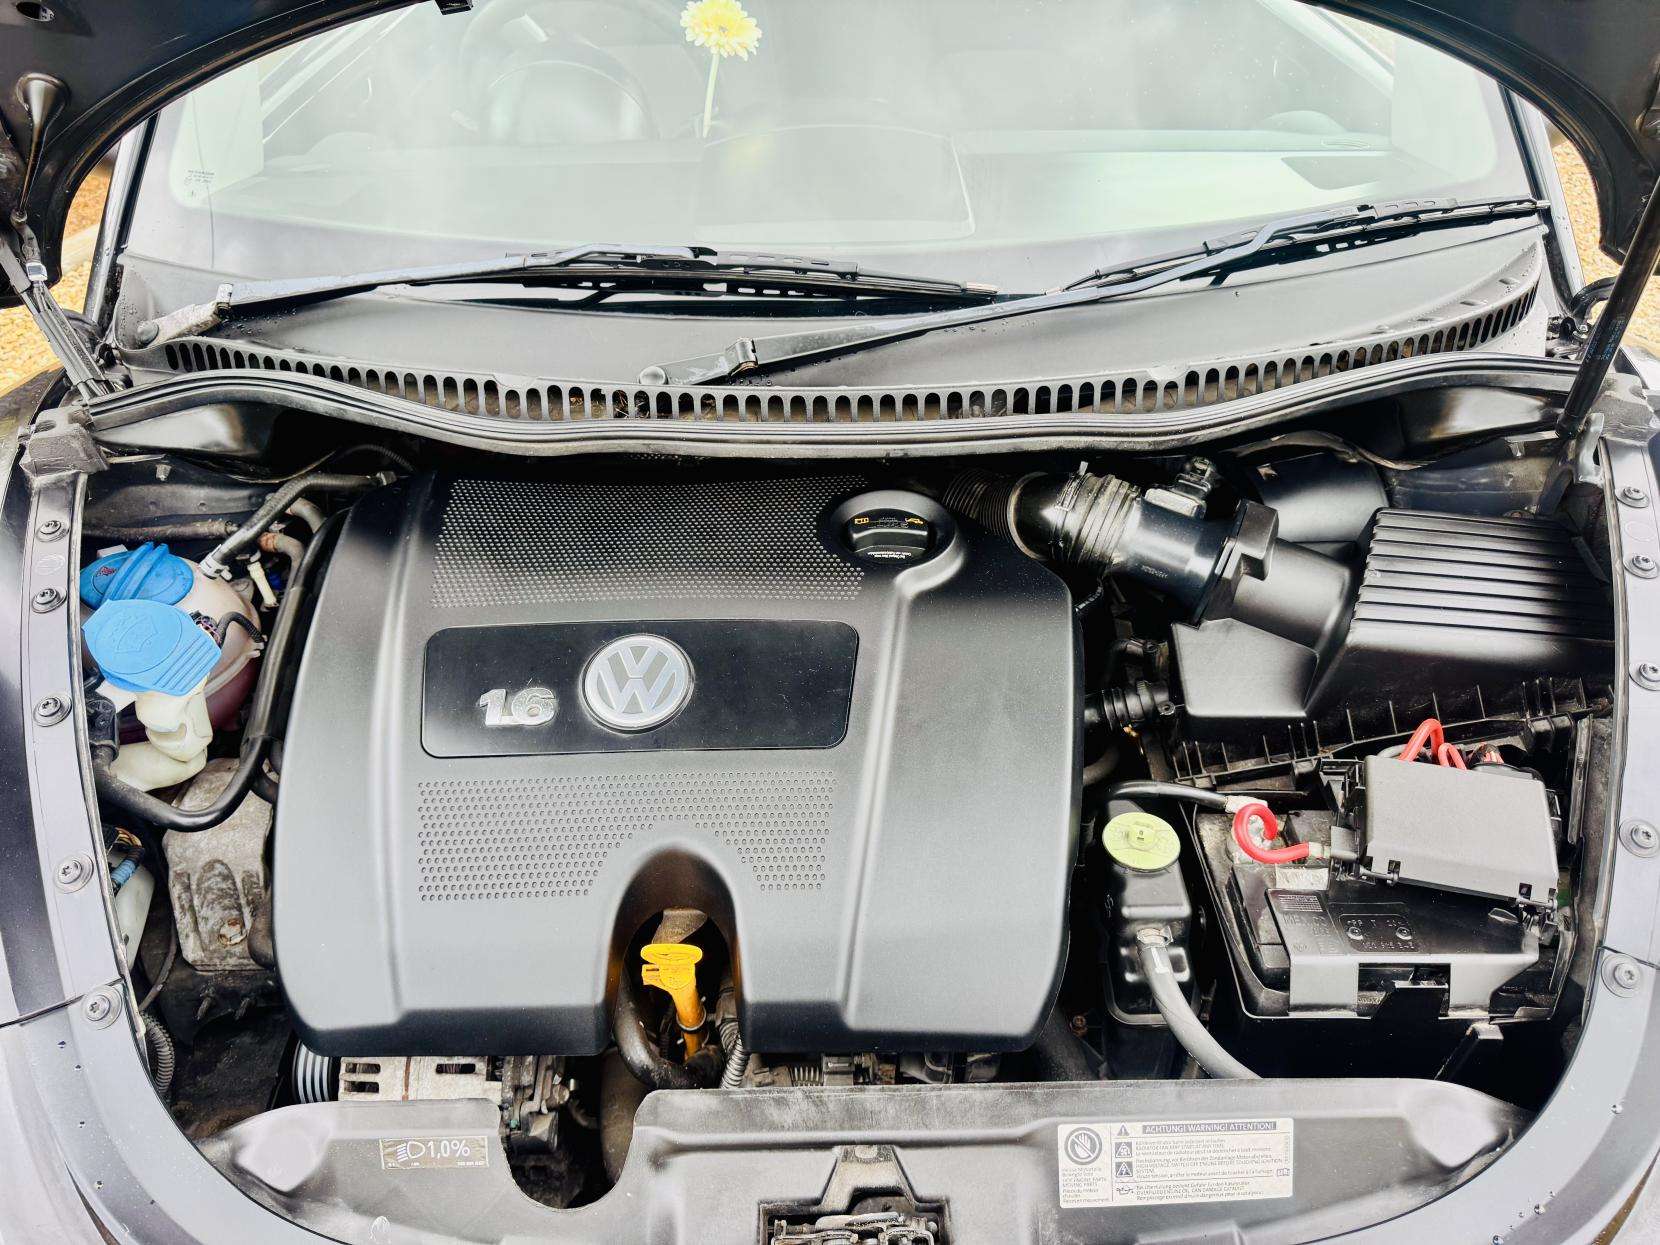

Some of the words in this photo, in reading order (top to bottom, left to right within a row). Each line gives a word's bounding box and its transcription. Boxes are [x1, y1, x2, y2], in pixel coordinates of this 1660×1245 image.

[1145, 1124, 1186, 1134] ACHTUNG!
[1187, 1123, 1228, 1132] WARNING!
[1229, 1121, 1275, 1131] ATTENTION!
[427, 1140, 470, 1158] 1,0%
